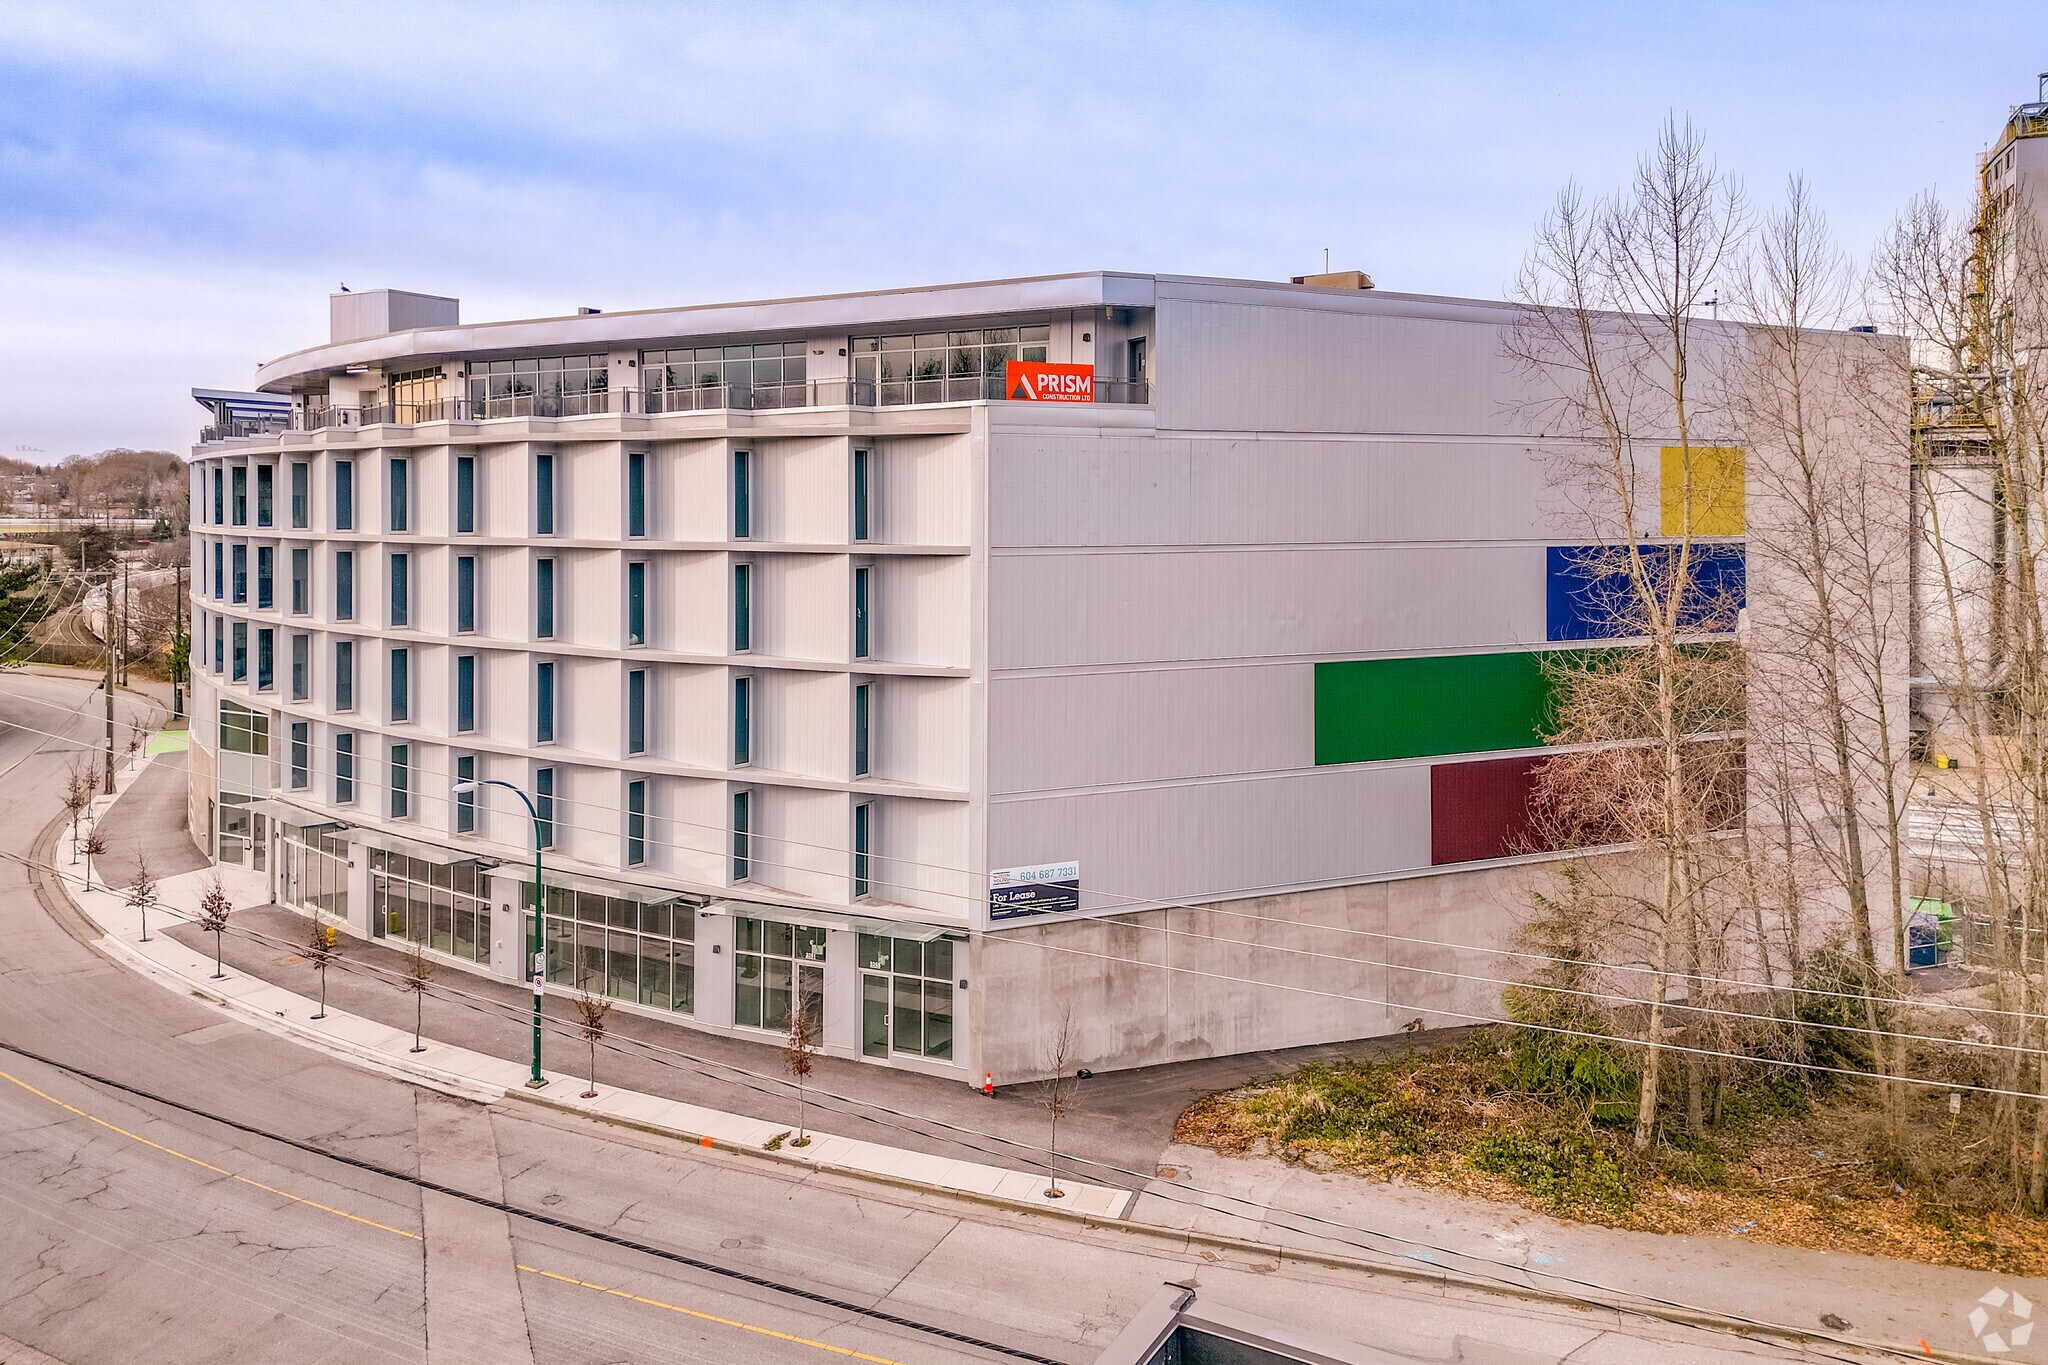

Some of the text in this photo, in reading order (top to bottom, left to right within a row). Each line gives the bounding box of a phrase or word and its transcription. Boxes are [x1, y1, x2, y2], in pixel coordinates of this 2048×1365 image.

[1037, 373, 1091, 393] PRISM
[1042, 393, 1081, 401] CONSTRUCTION
[1020, 866, 1077, 881] 604 687 7331
[992, 893, 1008, 902] For
[1009, 891, 1036, 901] Lease
